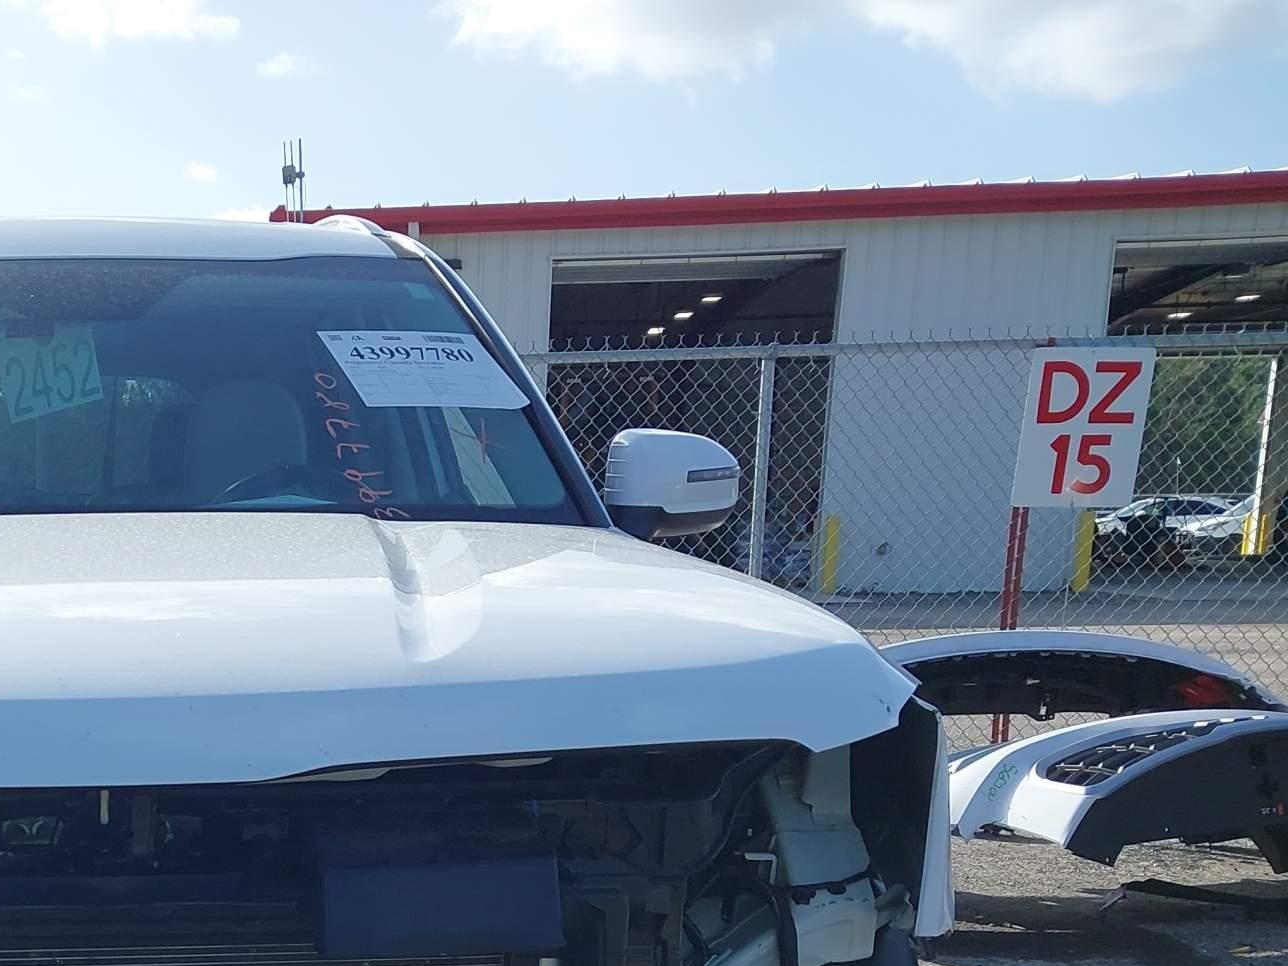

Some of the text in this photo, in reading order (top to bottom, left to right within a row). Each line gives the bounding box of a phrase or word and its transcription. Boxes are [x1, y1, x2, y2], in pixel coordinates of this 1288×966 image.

[4, 339, 101, 417] 2452
[349, 345, 475, 364] 43997780
[1035, 360, 1144, 425] DZ
[1049, 433, 1113, 496] 15
